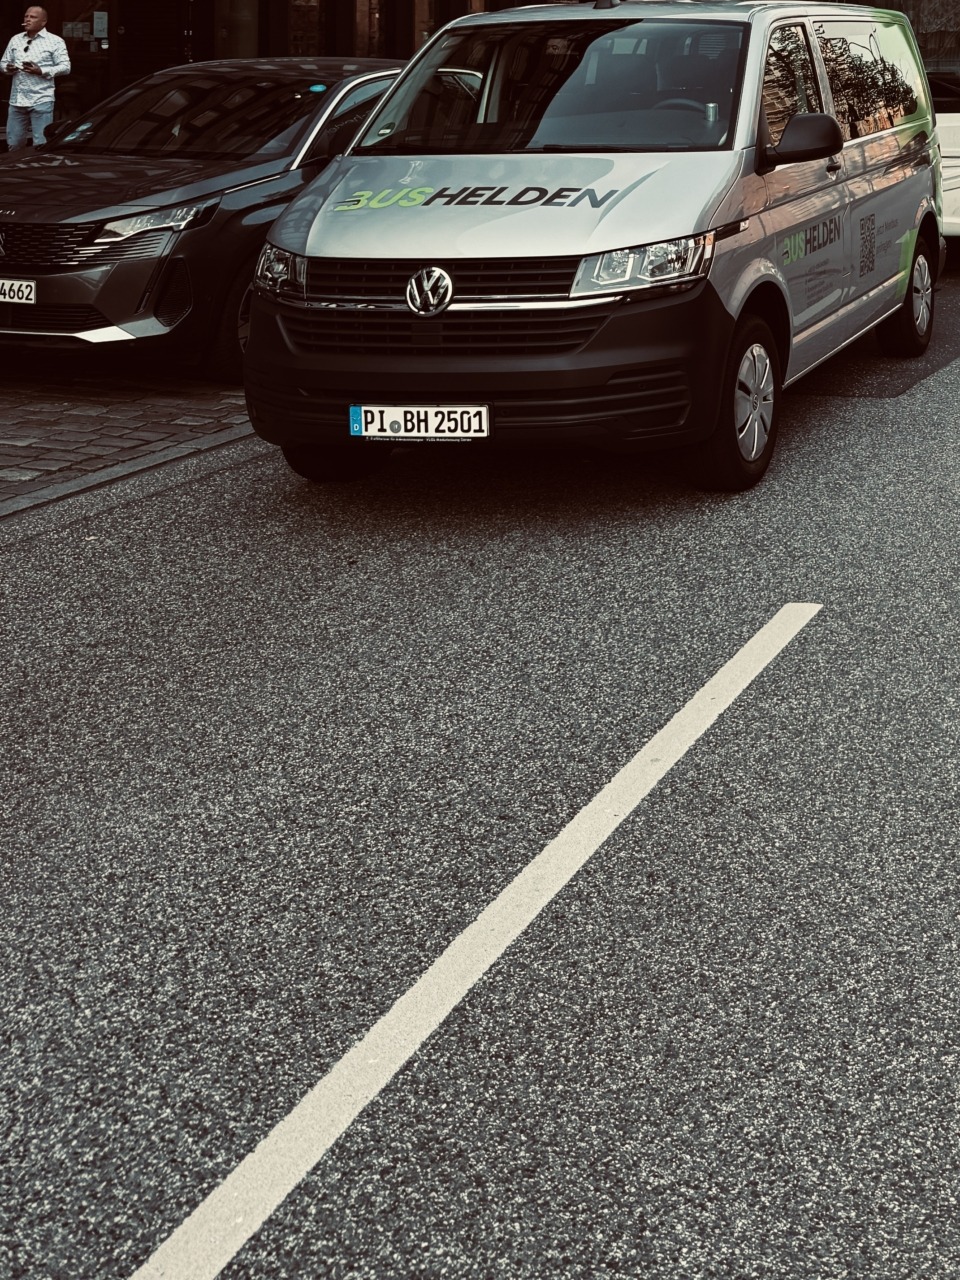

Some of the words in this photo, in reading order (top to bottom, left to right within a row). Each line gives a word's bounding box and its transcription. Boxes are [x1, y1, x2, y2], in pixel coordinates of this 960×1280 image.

[334, 186, 619, 211] BUSHELDEN
[406, 266, 453, 317] VW
[353, 423, 360, 431] D
[363, 409, 387, 433] PI
[403, 410, 429, 433] BH
[434, 410, 485, 433] 2501
